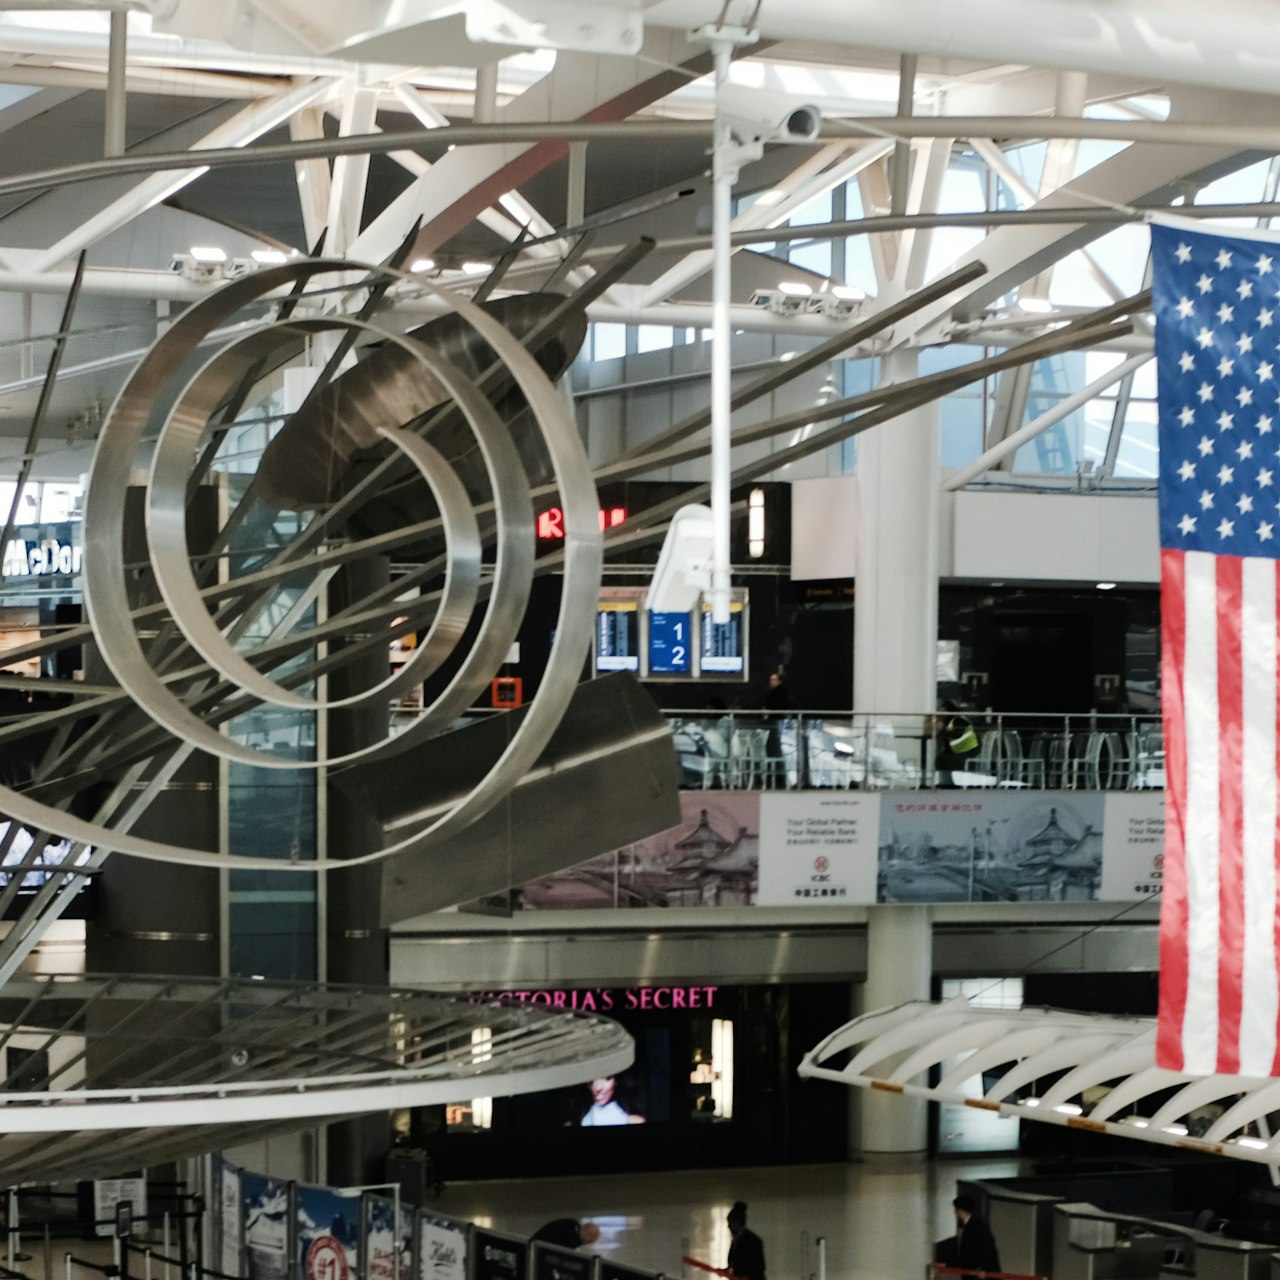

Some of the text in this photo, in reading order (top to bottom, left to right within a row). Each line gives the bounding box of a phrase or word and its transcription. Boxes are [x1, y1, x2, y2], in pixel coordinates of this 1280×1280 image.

[673, 622, 683, 641] 1
[671, 646, 685, 665] 2
[624, 986, 718, 1010] SECRET
